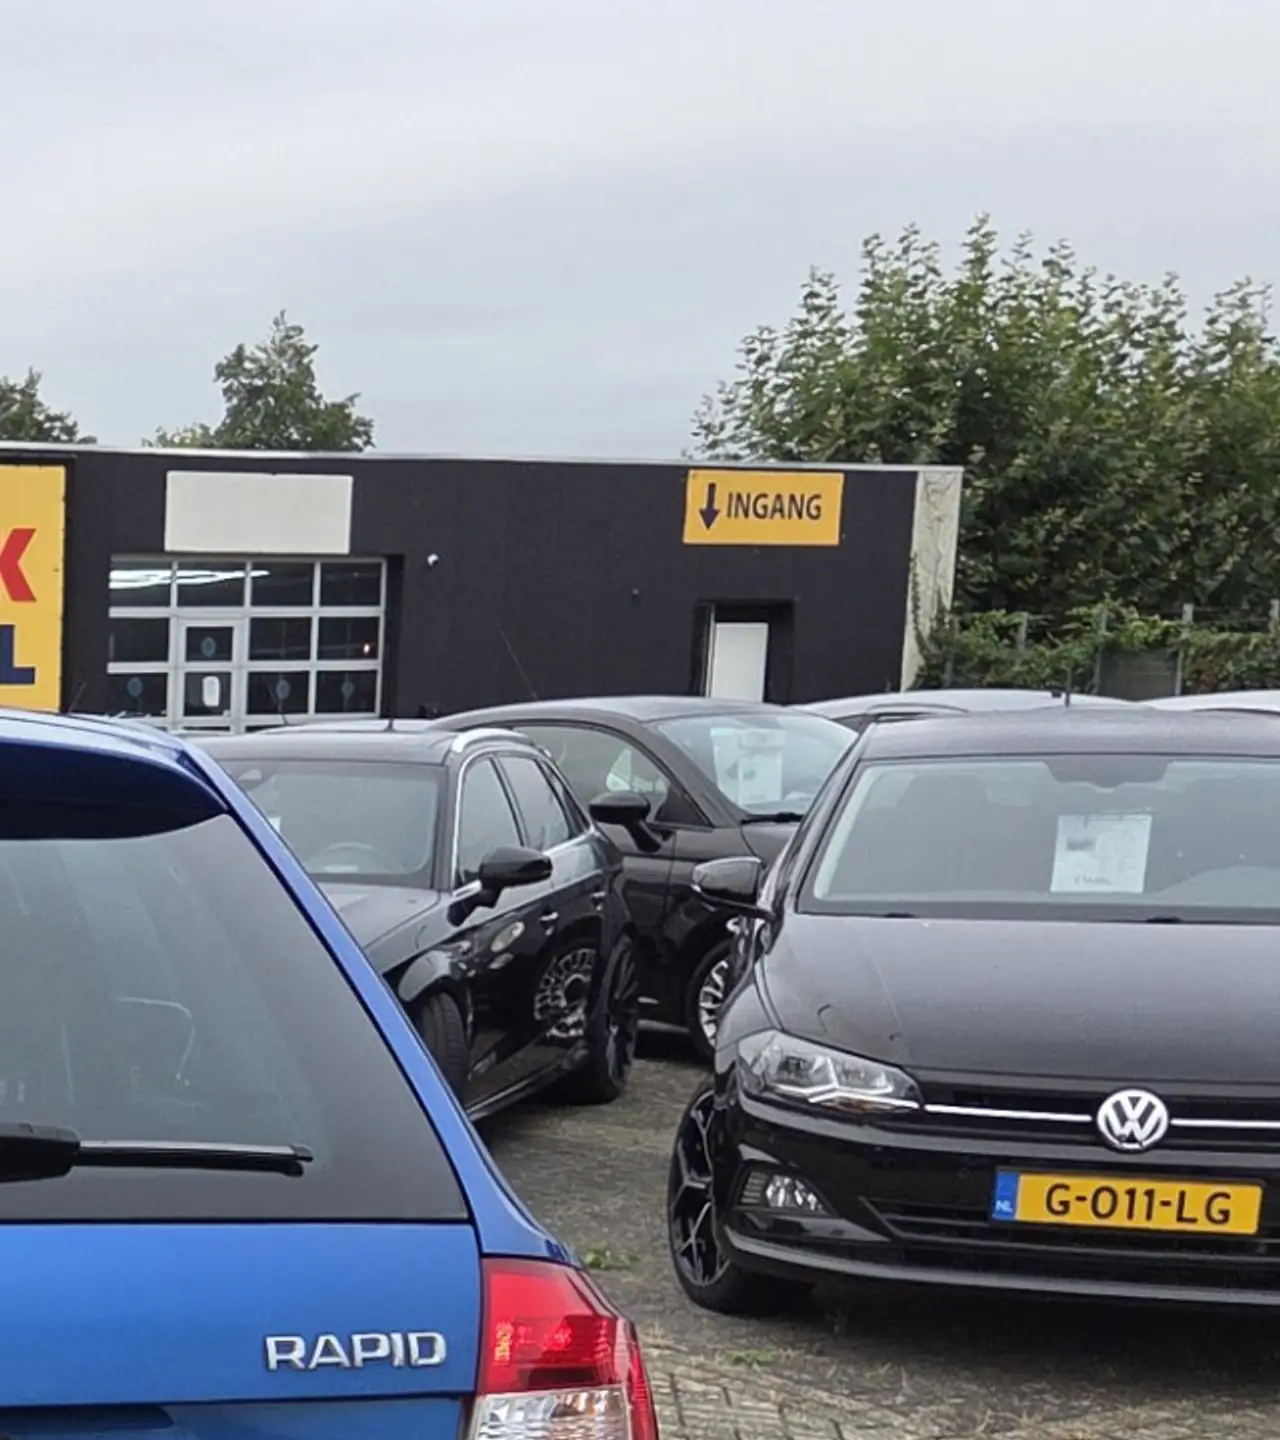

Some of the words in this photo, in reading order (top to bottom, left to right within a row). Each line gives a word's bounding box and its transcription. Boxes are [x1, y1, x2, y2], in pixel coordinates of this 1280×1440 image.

[727, 492, 823, 520] INGANG
[995, 1200, 1013, 1213] NL
[1045, 1183, 1232, 1225] G-011-LG
[265, 1331, 447, 1371] RAPID
